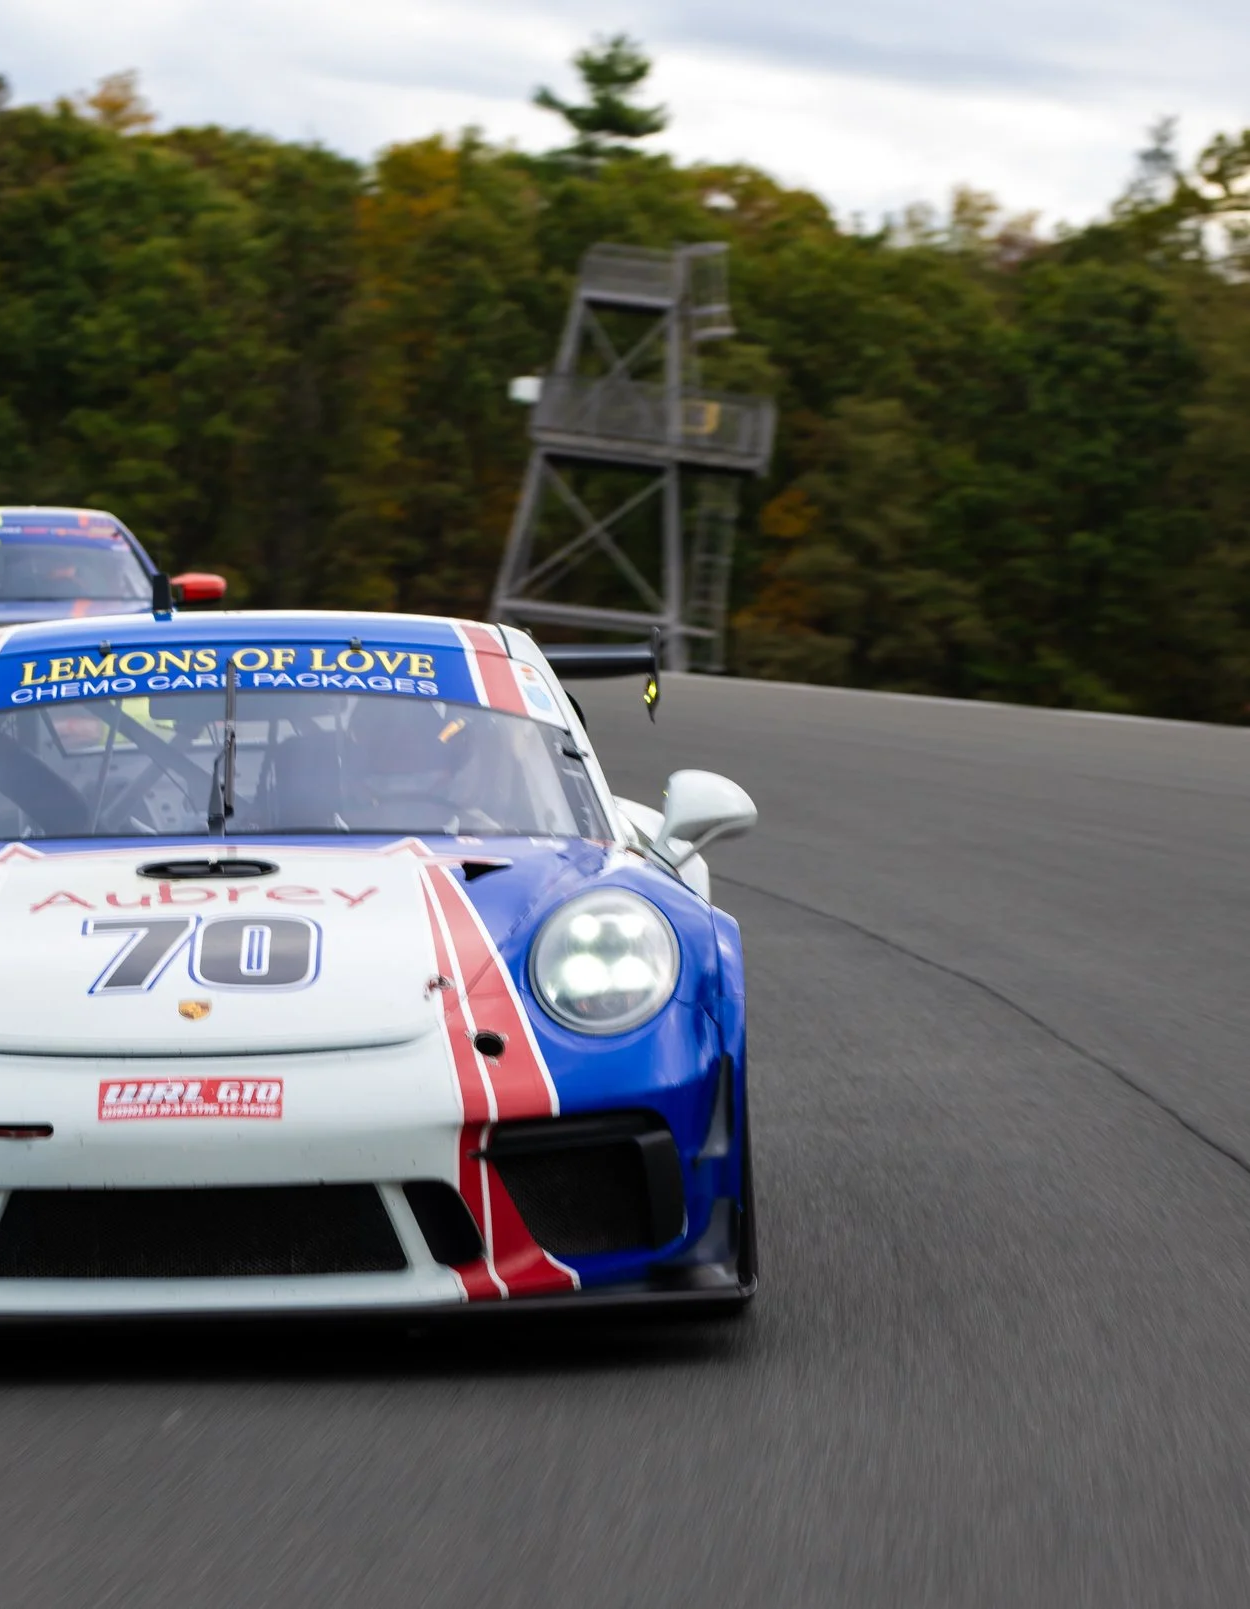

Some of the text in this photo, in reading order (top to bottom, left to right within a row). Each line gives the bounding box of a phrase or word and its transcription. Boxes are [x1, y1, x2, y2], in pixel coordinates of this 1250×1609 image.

[20, 647, 436, 687] LEMONS OF LOVE
[10, 677, 137, 704] CHEMO
[253, 672, 439, 696] PACKAGES
[29, 880, 381, 914] Aubrey
[81, 912, 324, 997] 70
[103, 1080, 204, 1104] WRL
